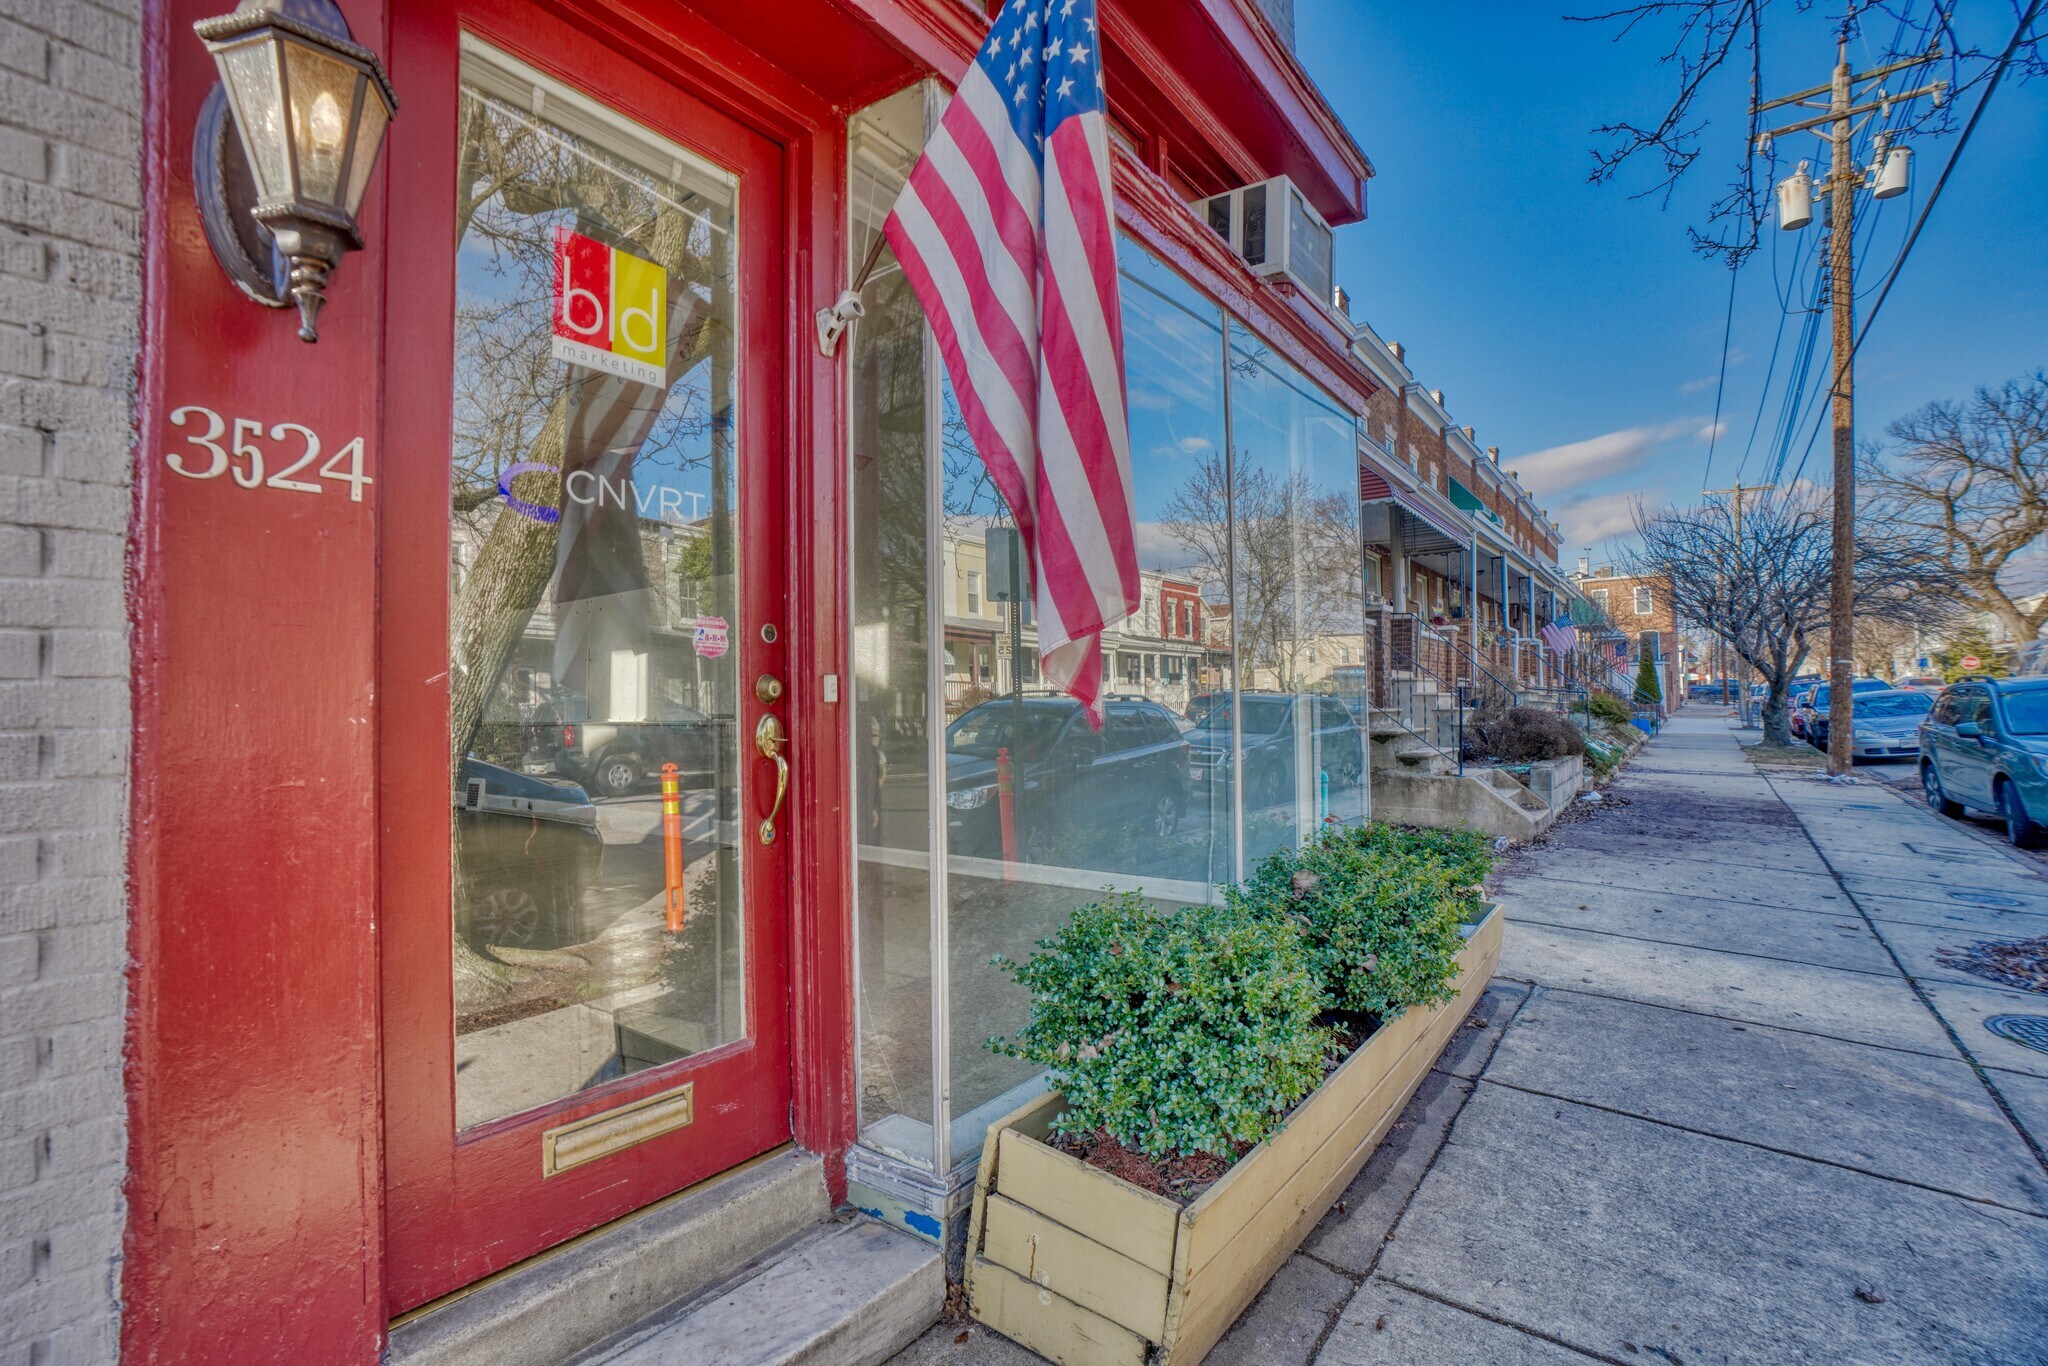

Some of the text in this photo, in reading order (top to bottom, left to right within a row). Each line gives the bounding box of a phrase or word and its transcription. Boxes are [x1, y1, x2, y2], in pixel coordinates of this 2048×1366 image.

[562, 344, 658, 383] marketing
[166, 405, 373, 503] 3524
[566, 470, 706, 522] CNVRT
